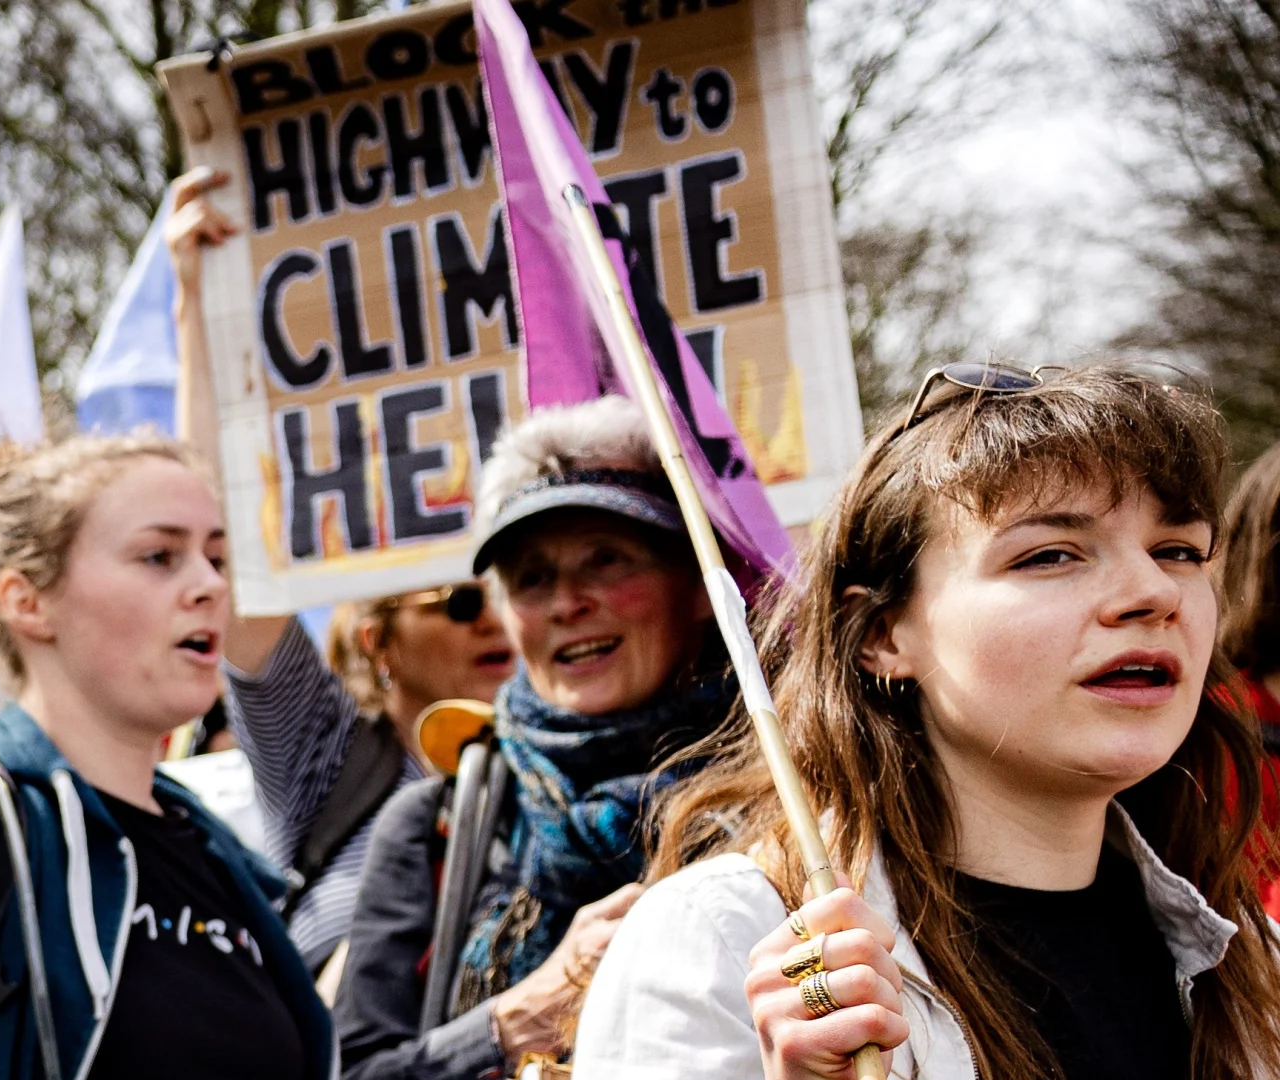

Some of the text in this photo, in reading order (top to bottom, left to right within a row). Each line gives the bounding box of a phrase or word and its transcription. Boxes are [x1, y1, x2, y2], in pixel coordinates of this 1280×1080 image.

[241, 43, 734, 231] HIGHWY to
[260, 153, 765, 387] CLIMTE
